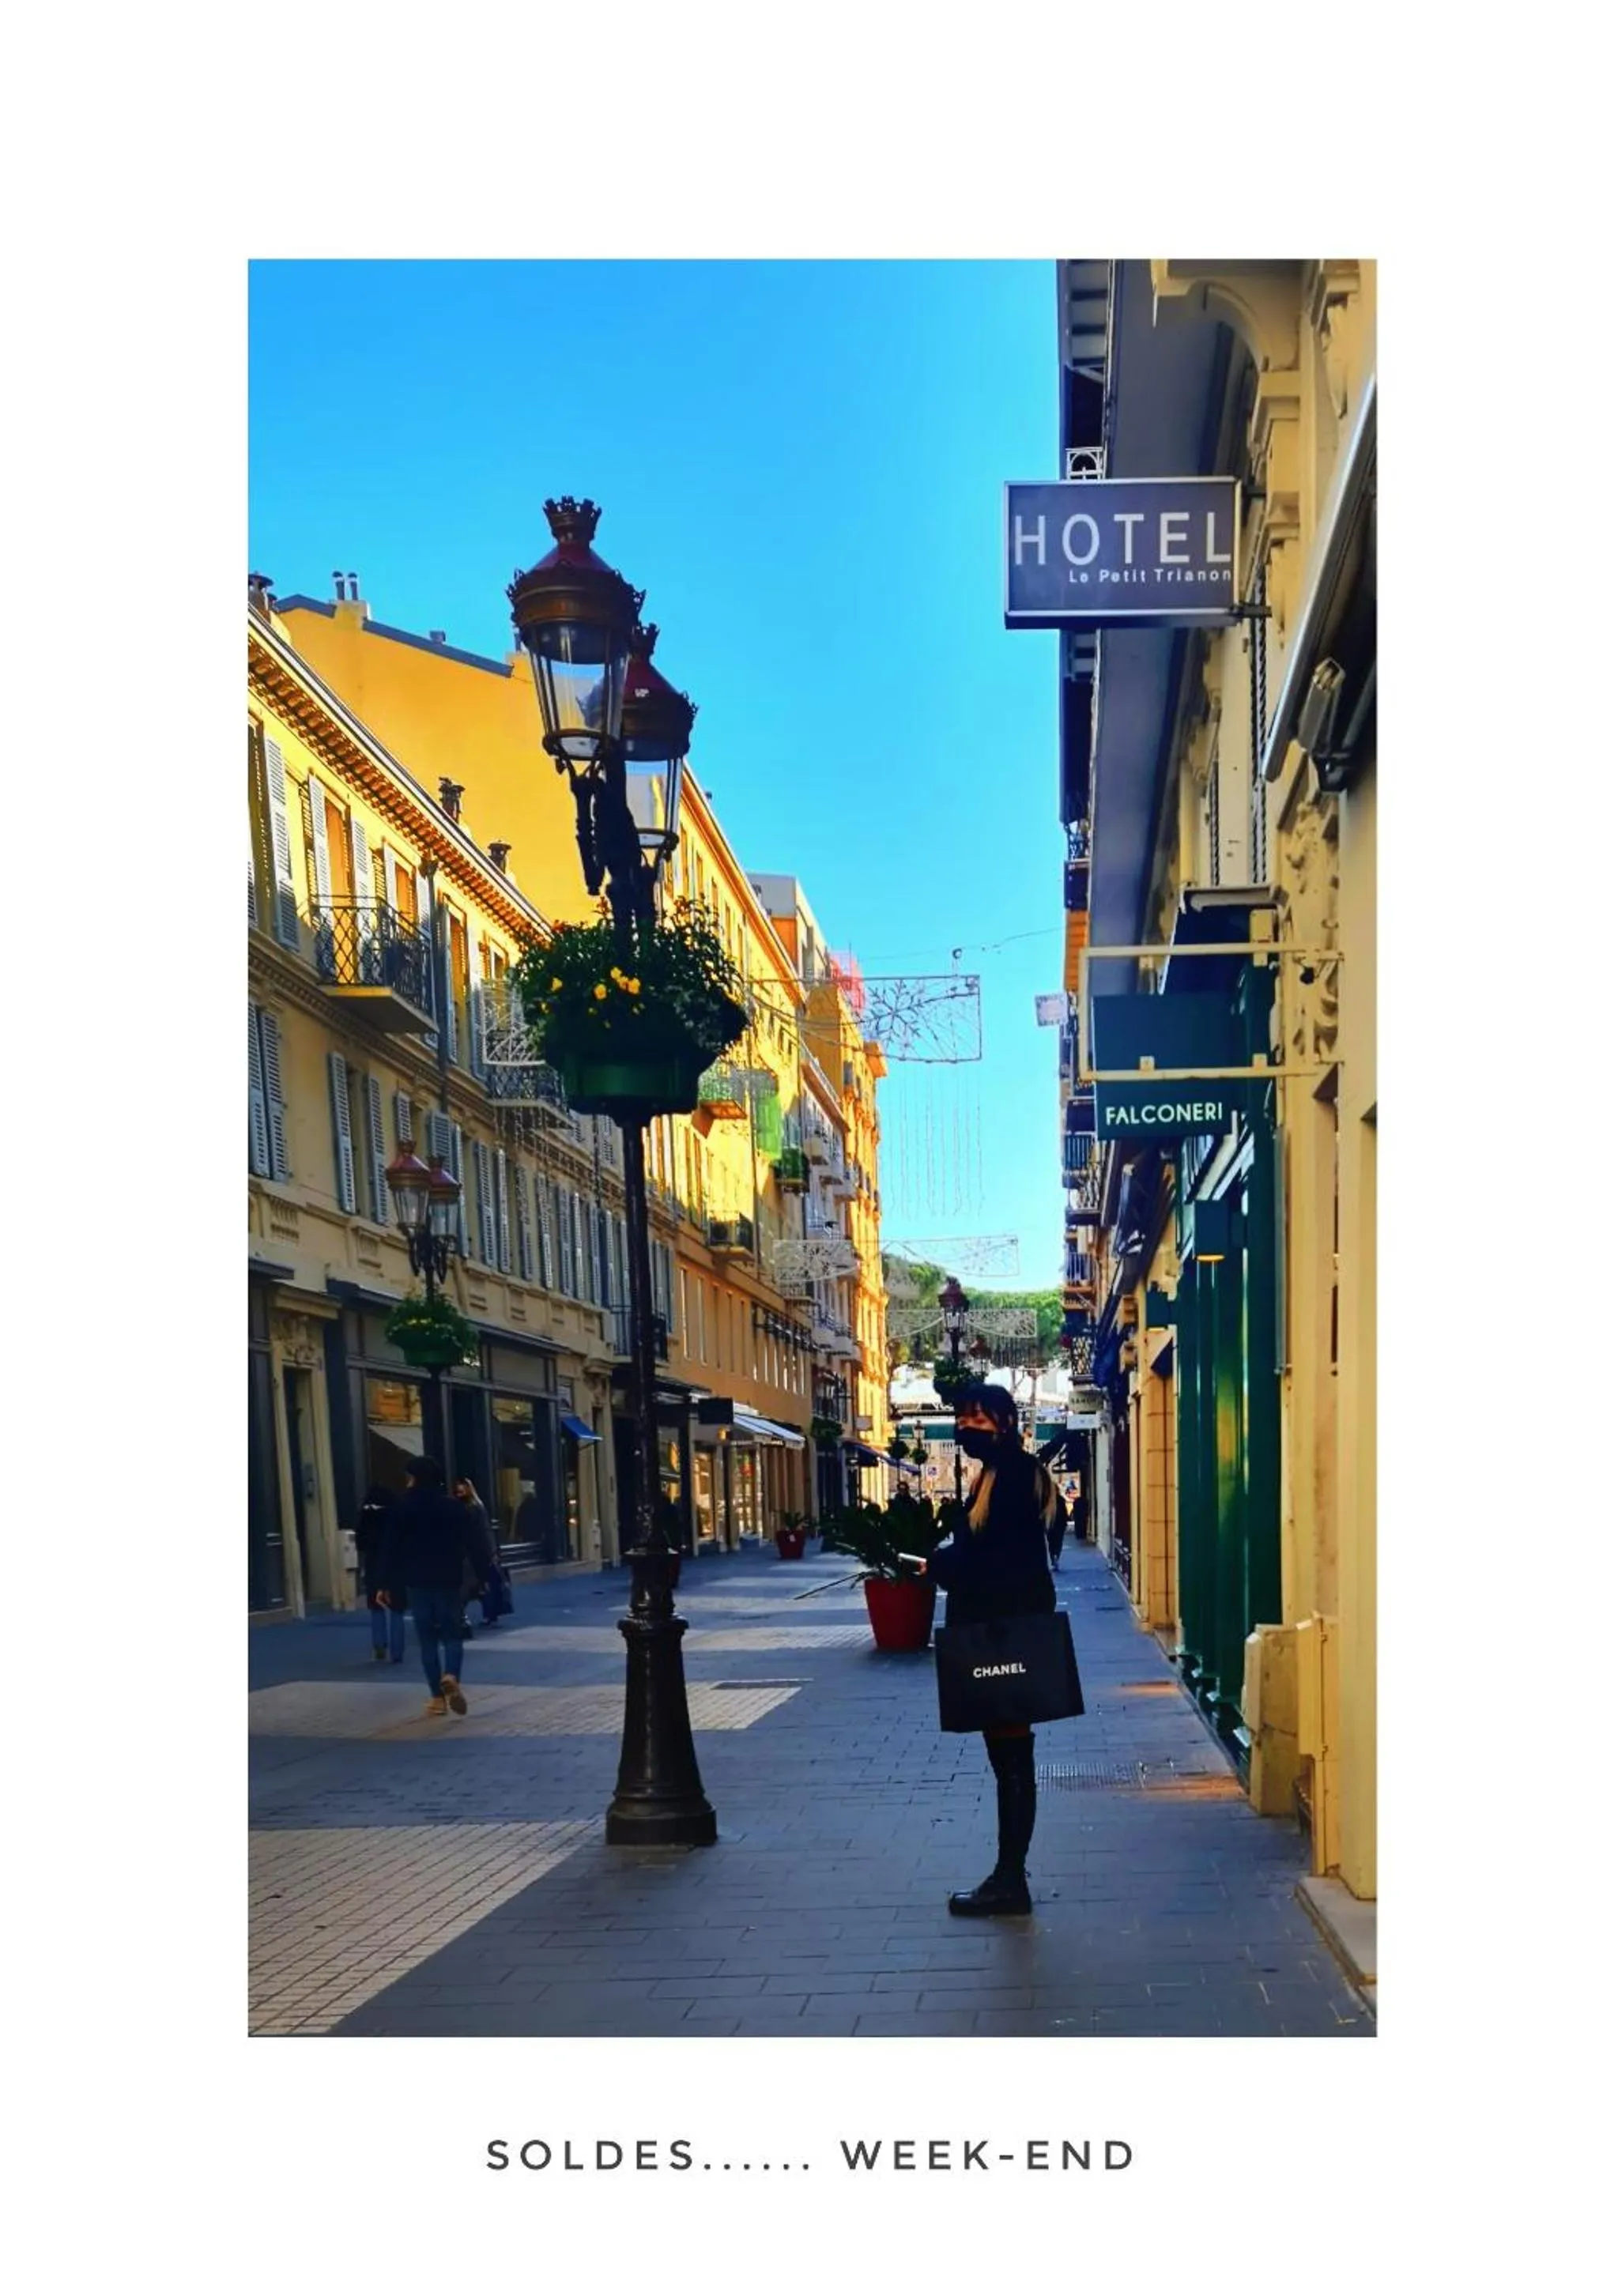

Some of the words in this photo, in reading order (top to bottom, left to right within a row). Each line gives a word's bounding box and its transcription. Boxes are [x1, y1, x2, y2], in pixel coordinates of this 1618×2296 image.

[1013, 512, 1232, 566] HOTEL
[1069, 568, 1089, 583] Le
[1099, 568, 1146, 583] Petit
[1153, 567, 1231, 582] Trianon
[1106, 1102, 1222, 1125] FALCONERI
[972, 1662, 1027, 1679] CHANEL
